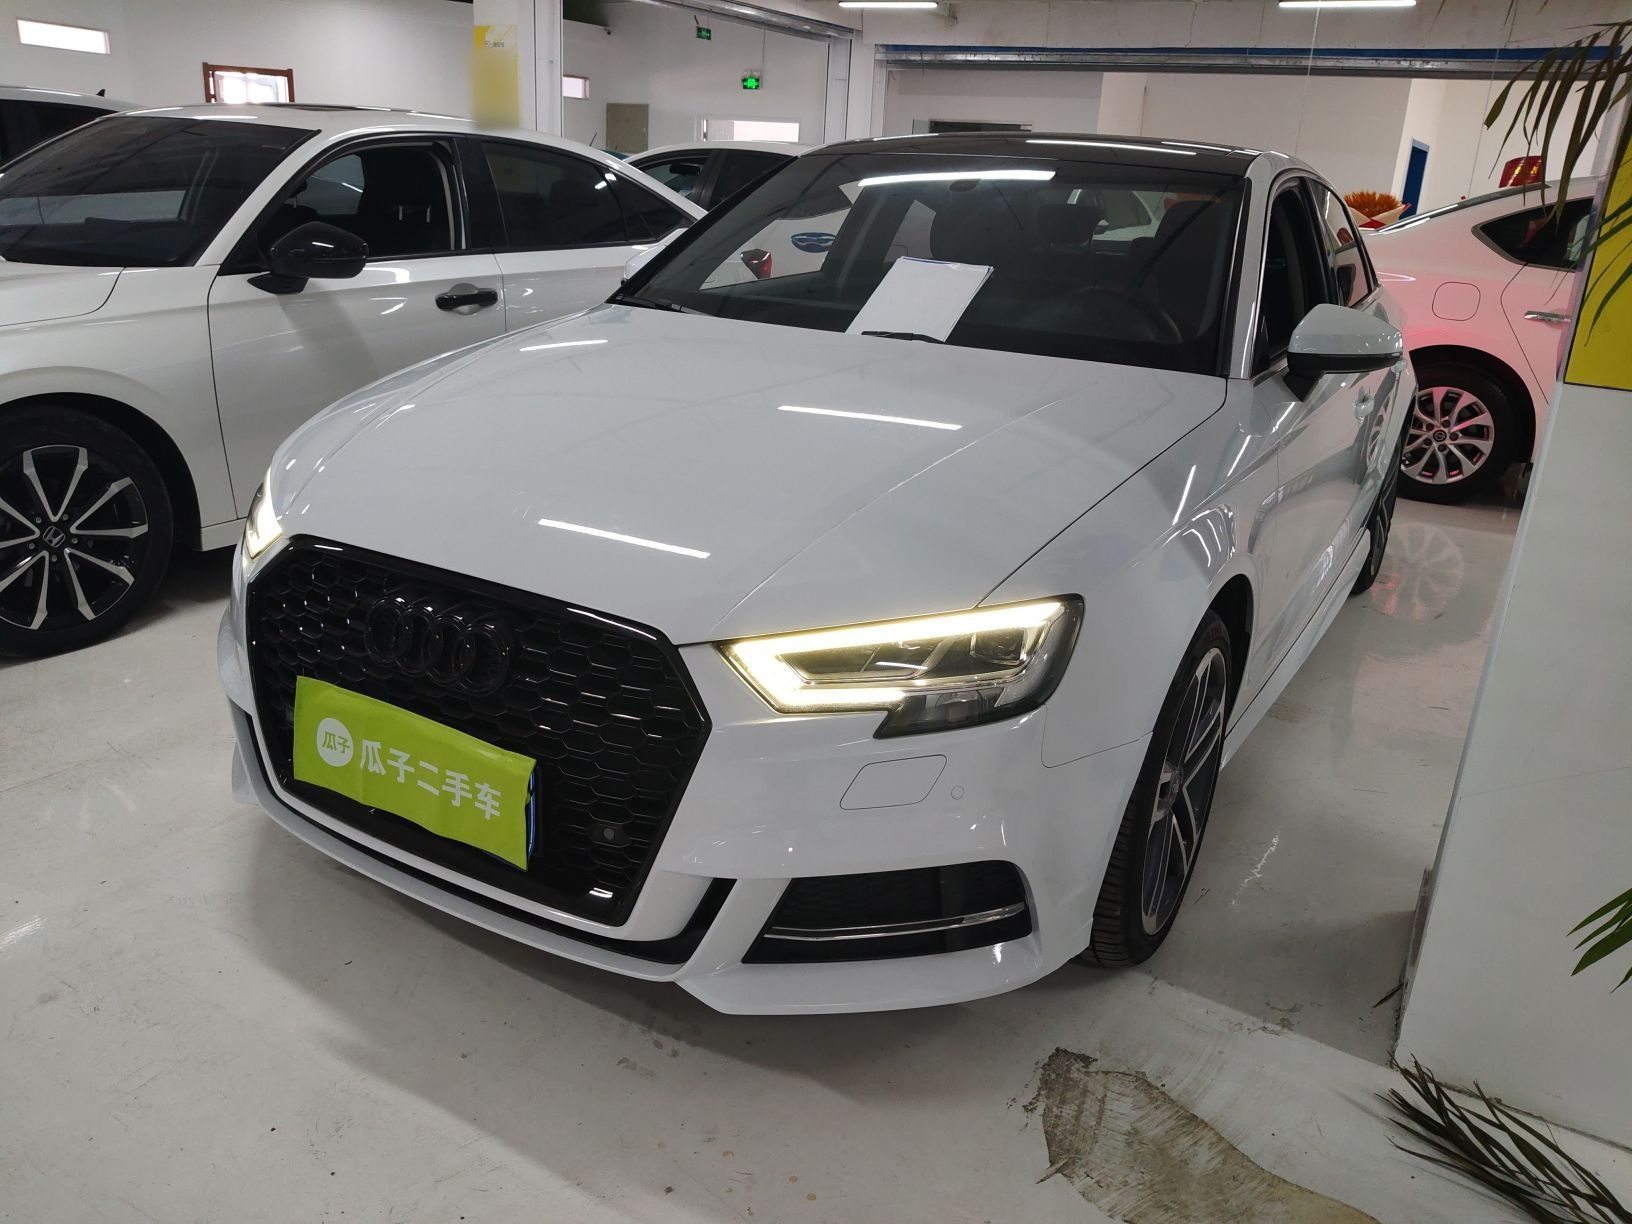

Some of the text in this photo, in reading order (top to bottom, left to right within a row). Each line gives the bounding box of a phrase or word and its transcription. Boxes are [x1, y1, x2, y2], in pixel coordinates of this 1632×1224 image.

[322, 731, 350, 754] 瓜子
[360, 739, 501, 820] 瓜子二手车
